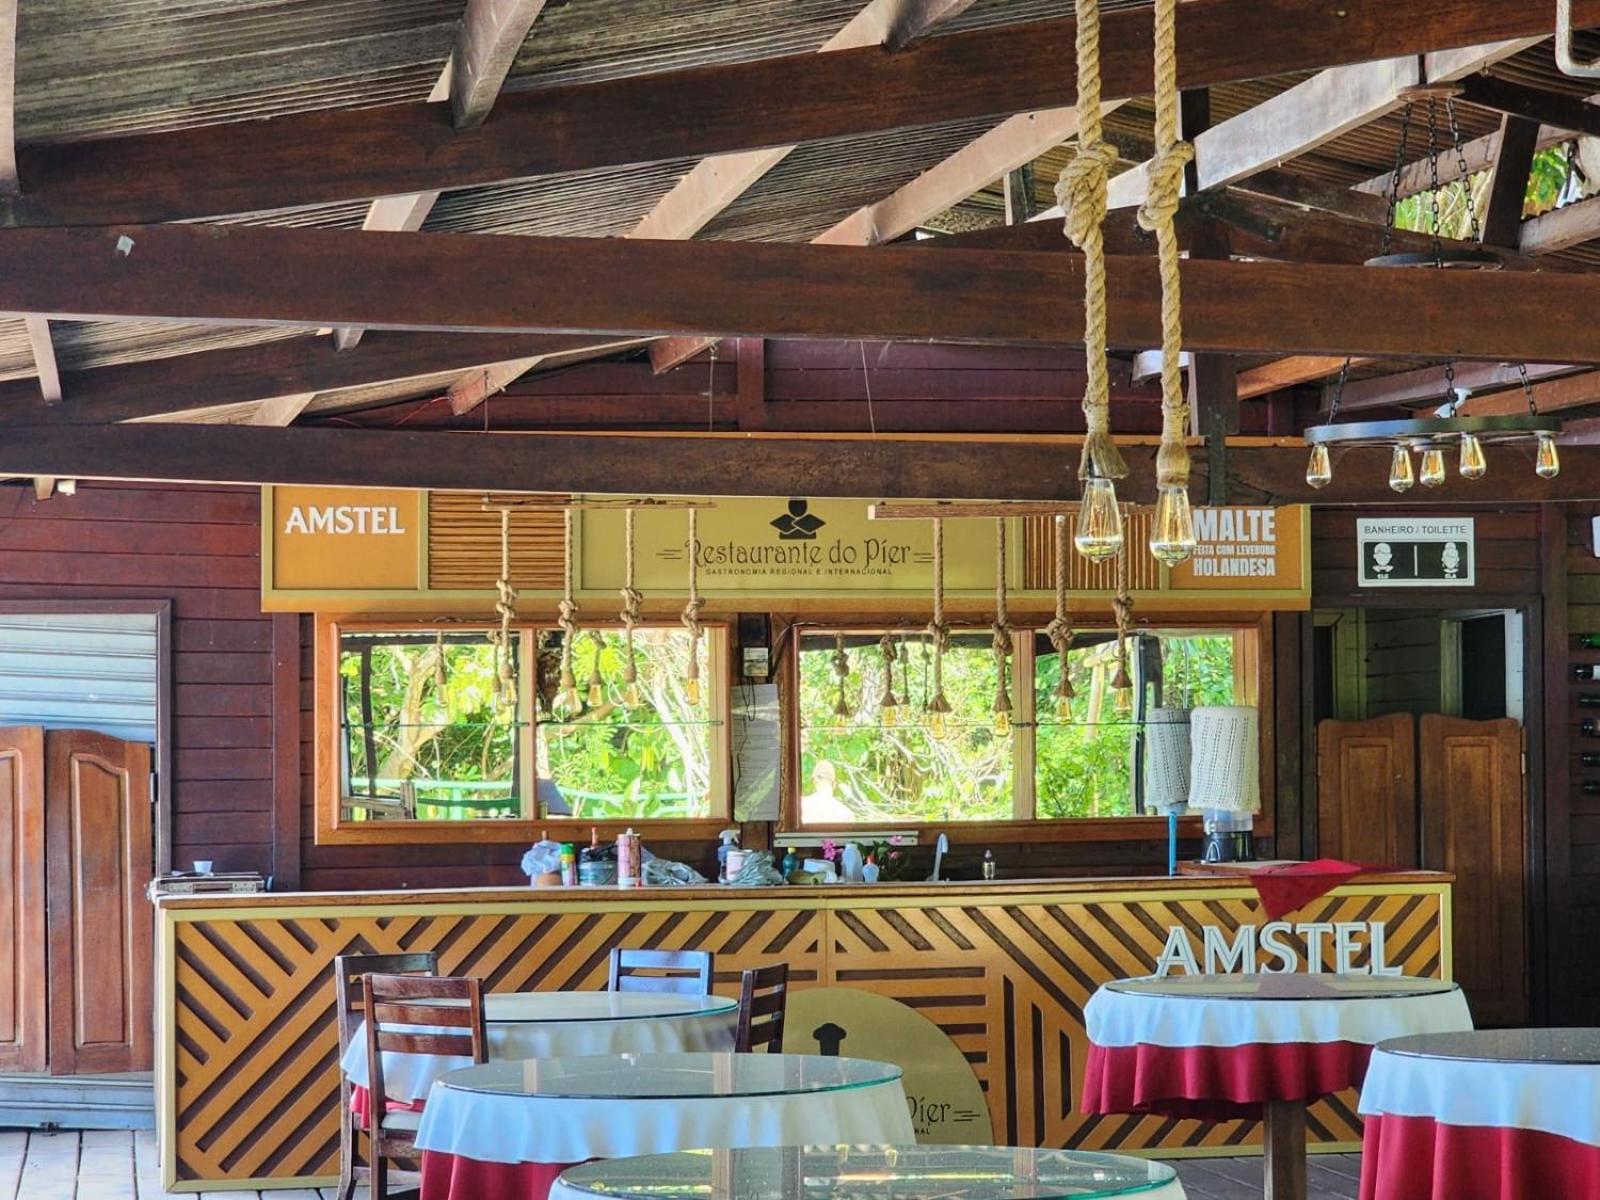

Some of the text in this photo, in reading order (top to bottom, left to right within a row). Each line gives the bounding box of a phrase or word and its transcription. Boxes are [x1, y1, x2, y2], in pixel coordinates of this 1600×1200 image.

[284, 506, 406, 535] AMSTEL
[1192, 509, 1276, 542] MALTE
[1364, 525, 1414, 535] BANHEIRO
[1421, 525, 1467, 535] TOILETTE
[684, 539, 822, 567] Restaurante
[828, 539, 857, 564] do
[1193, 558, 1276, 577] HOLANDESA
[1156, 921, 1404, 978] AMSTEL
